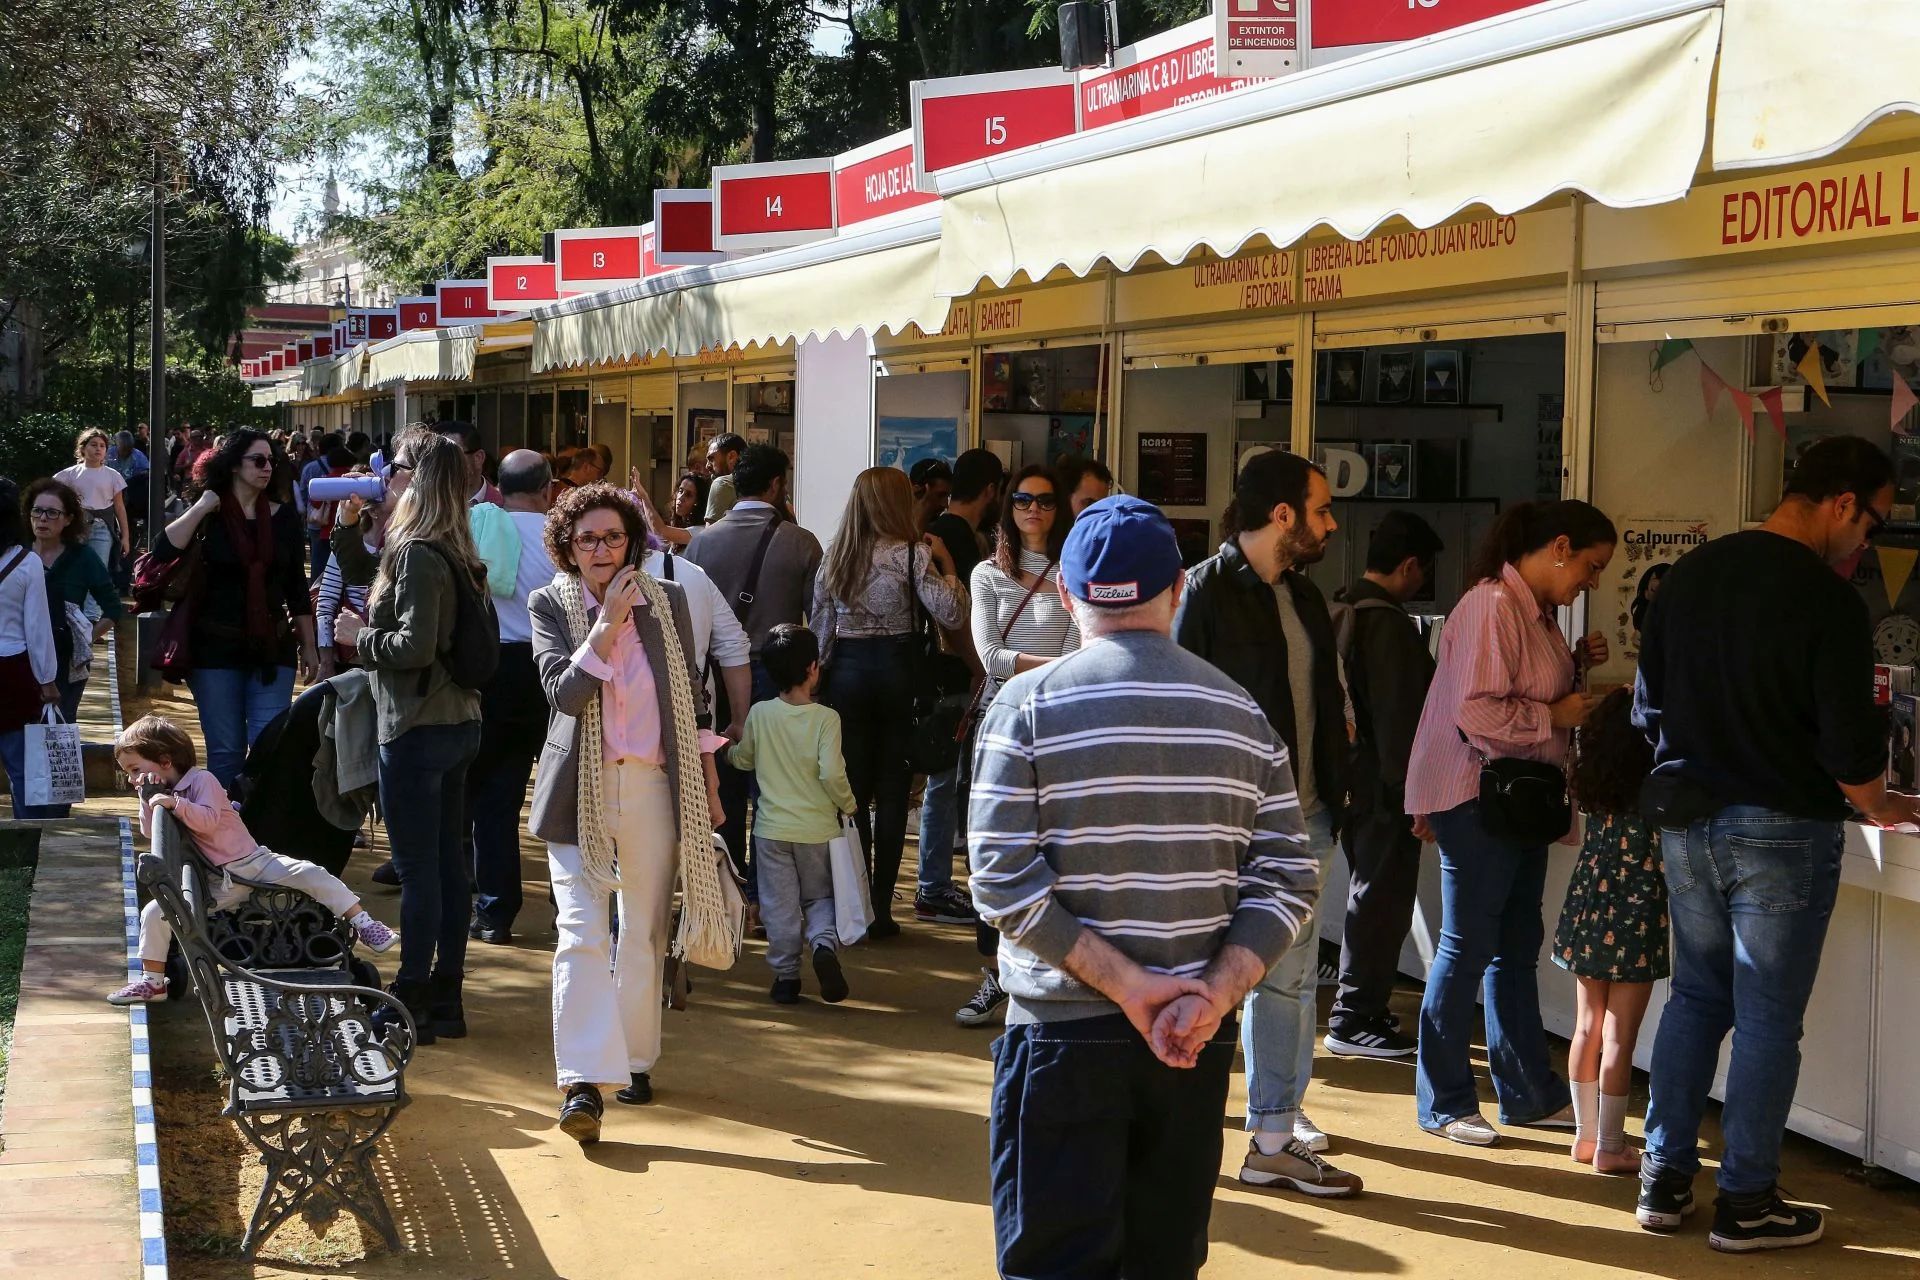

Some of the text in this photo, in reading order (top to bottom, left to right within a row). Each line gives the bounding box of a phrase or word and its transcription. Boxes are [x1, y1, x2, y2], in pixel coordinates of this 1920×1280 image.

[1239, 26, 1285, 34] EXTINTOR
[1230, 38, 1294, 46] DE INCENDIOS
[1087, 69, 1152, 112] ULTRAMARINA
[1152, 64, 1160, 92] C
[1161, 60, 1169, 87] &
[1170, 58, 1178, 86] D
[984, 116, 1008, 146] 15
[865, 171, 888, 204] HOJA
[888, 166, 900, 198] DE
[766, 194, 782, 218] 14
[1722, 171, 1890, 245] EDITORIAL
[592, 252, 605, 268] 13
[1194, 256, 1260, 288] ULTRAMARINA
[1262, 255, 1269, 280] C
[1271, 254, 1278, 278] &
[1281, 252, 1288, 276] D
[1356, 238, 1378, 266] DEL
[1380, 230, 1428, 262] FONDO
[1430, 224, 1466, 256] JUAN
[1470, 216, 1516, 250] RULFO
[517, 276, 528, 290] 12
[1246, 280, 1294, 309] EDTORIAL
[1304, 274, 1342, 302] TRAMA
[464, 296, 472, 308] 11
[418, 312, 428, 324] 10
[948, 308, 969, 336] LATA
[981, 298, 1022, 332] BARRETT
[386, 322, 393, 333] 9
[1141, 438, 1172, 447] RCA24
[1624, 530, 1708, 550] Calpurnia
[1093, 587, 1134, 598] Titleist
